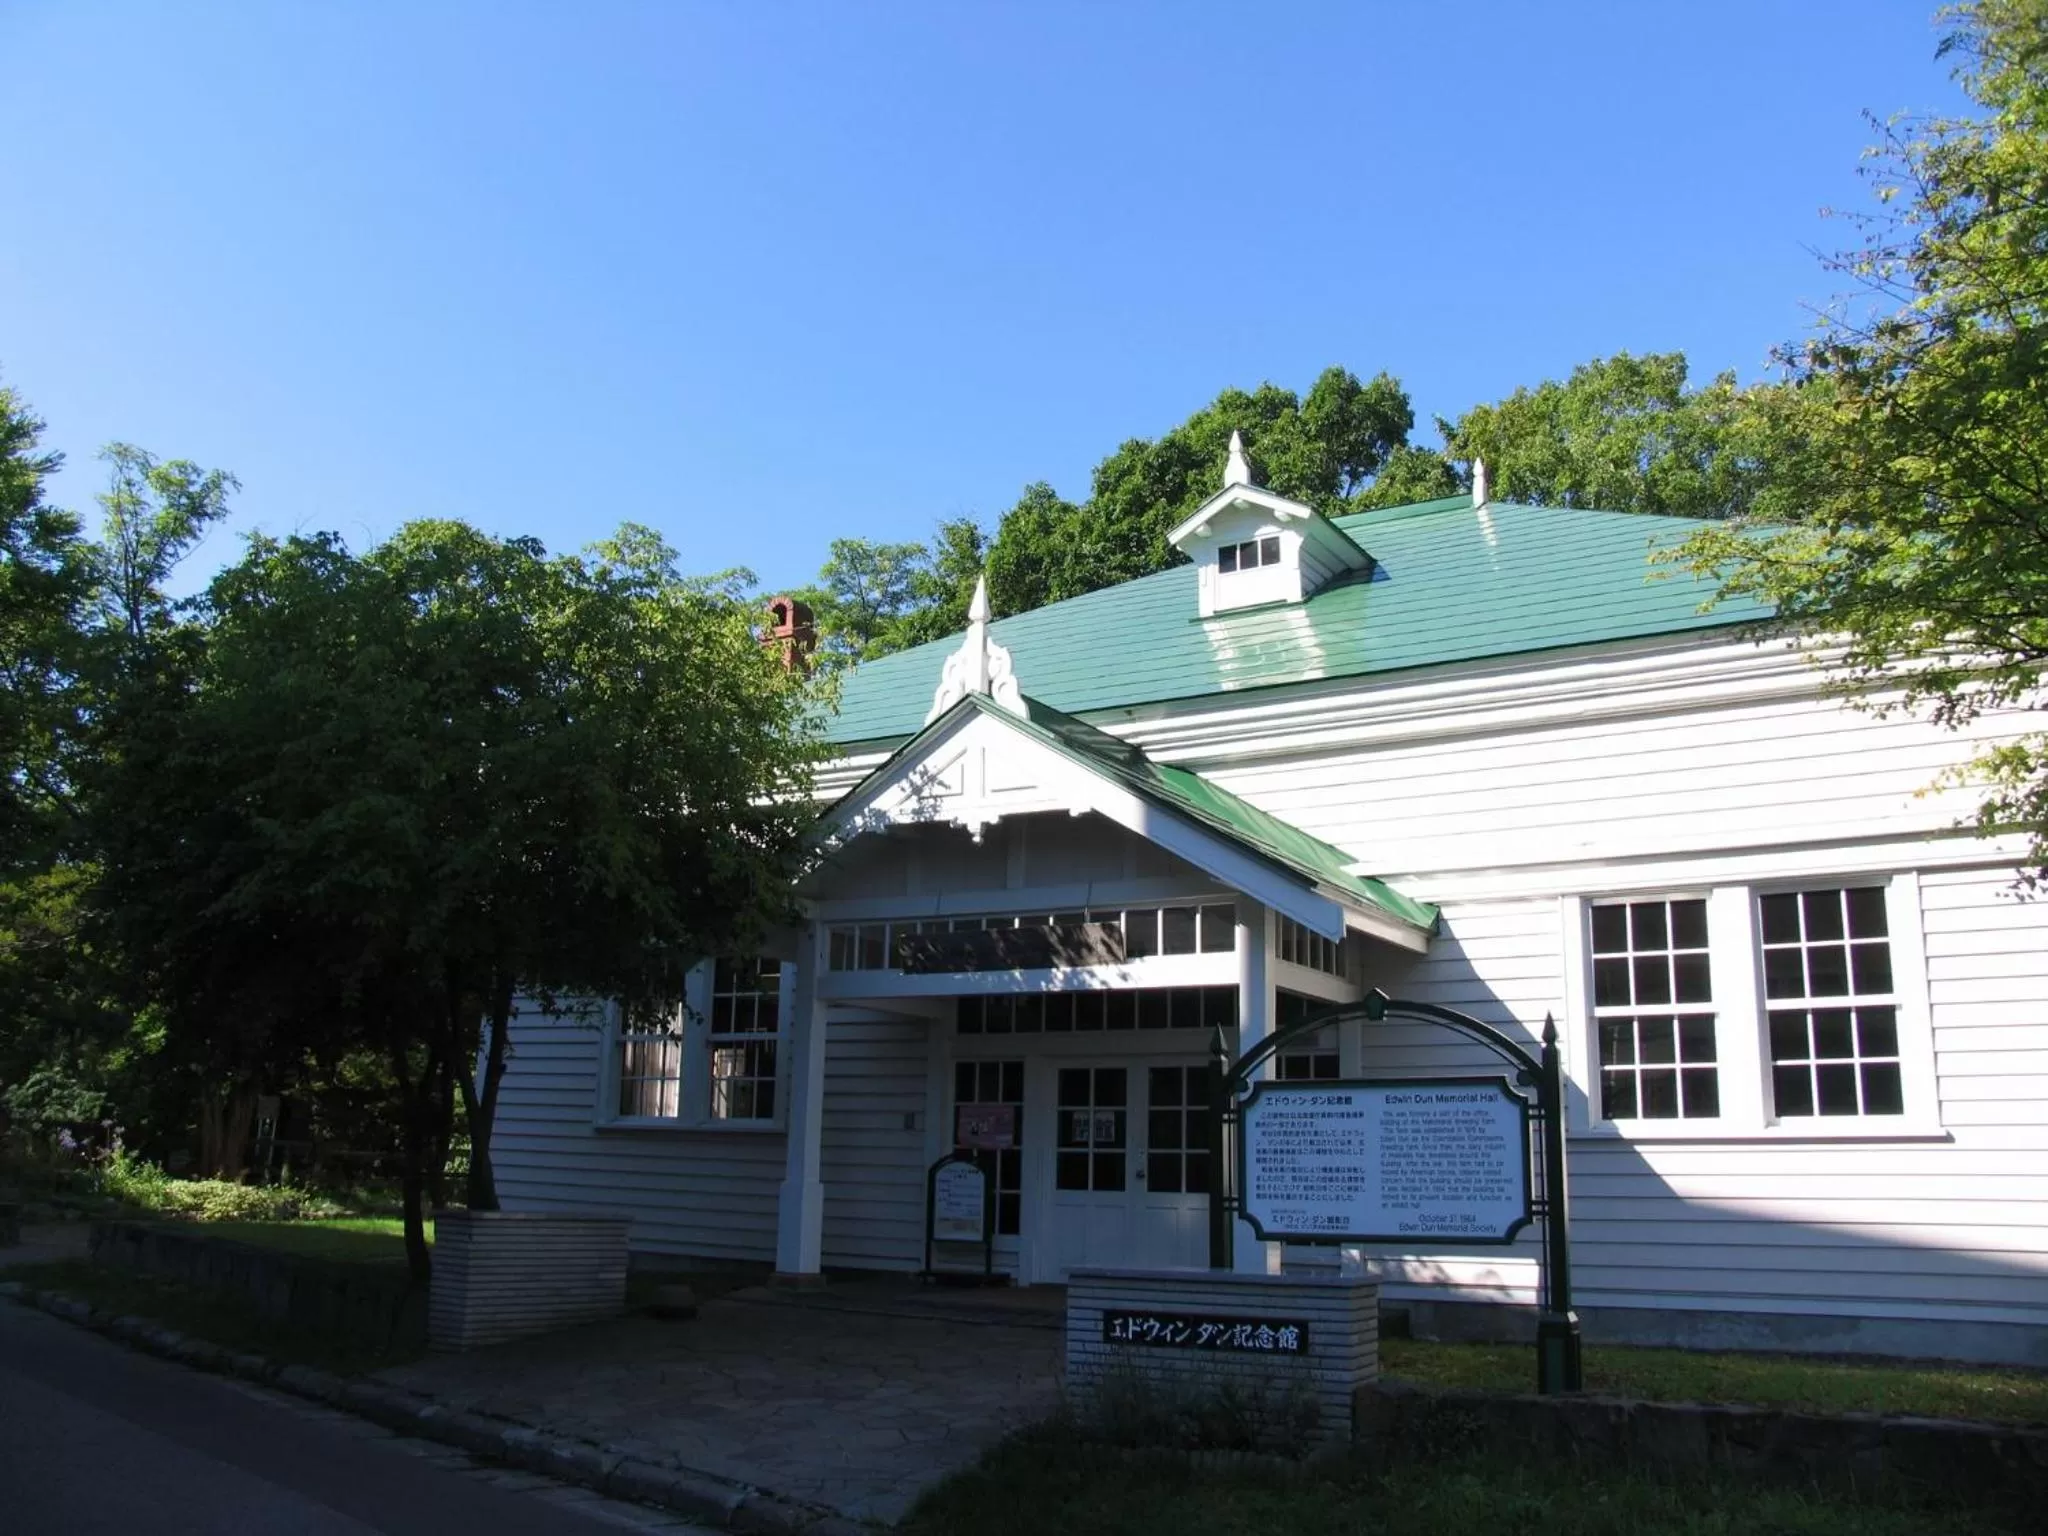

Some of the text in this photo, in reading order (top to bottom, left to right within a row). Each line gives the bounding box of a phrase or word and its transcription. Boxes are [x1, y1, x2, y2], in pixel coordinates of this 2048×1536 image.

[1385, 1093, 1498, 1104] Edwin Dun Memorial Hall
[1470, 1224, 1496, 1233] Society
